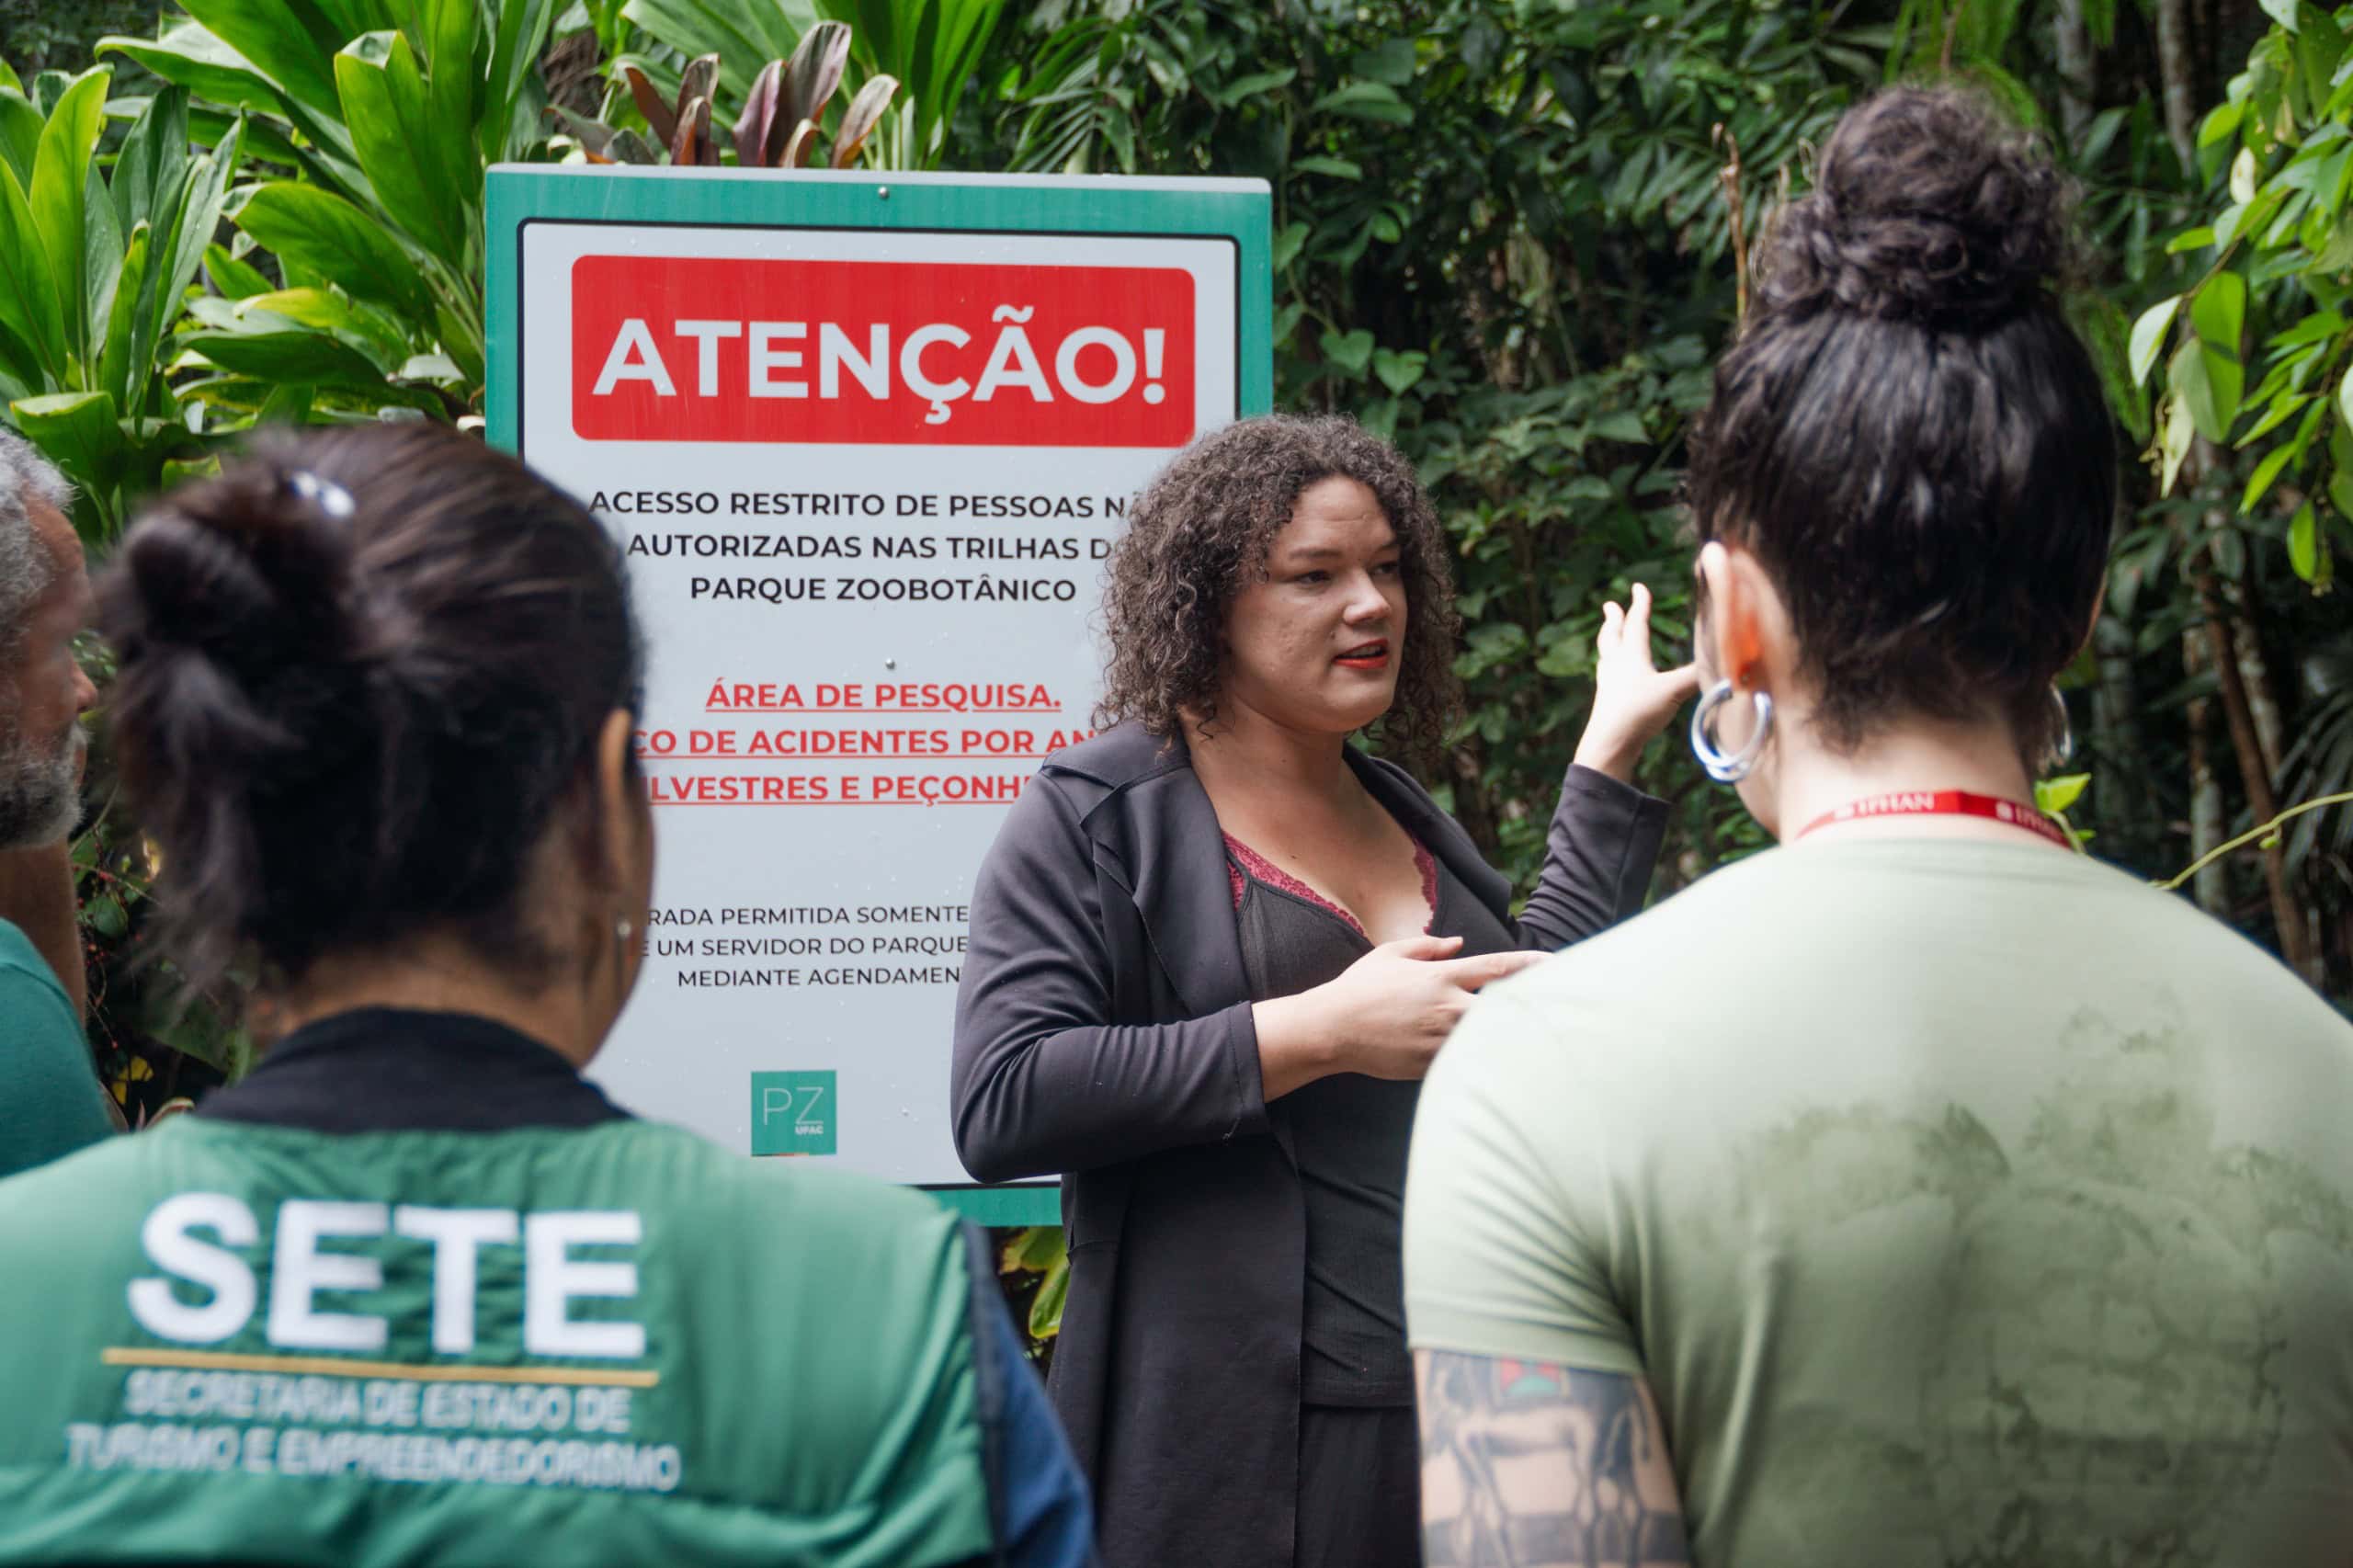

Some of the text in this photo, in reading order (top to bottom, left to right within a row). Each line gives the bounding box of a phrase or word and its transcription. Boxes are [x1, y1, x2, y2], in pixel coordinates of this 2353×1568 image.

[592, 303, 1165, 426] ATENÇÃO!
[588, 491, 720, 514] ACESSO
[730, 493, 885, 516] RESTRITO
[896, 494, 938, 517] DE
[949, 495, 1094, 517] PESSOAS
[627, 534, 862, 558] AUTORIZADAS
[872, 537, 937, 559] NAS
[947, 538, 1079, 560] TRILHAS
[691, 574, 1076, 604] PARQUE ZOOBOTÂNICO
[705, 676, 1062, 712] ÁREA DE PESQUISA.
[689, 730, 736, 754] DE
[748, 729, 949, 754] ACIDENTES
[961, 729, 1035, 754] POR
[643, 775, 1030, 807] LVESTRES E PEÇONH
[647, 905, 969, 926] RADA PERMITIDA SOMENTE
[657, 939, 693, 957] UM
[702, 937, 822, 956] SERVIDOR
[830, 937, 865, 955] DO
[873, 936, 969, 957] PARQUE
[677, 966, 960, 987] MEDIANTE AGENDAMEN
[763, 1086, 824, 1126] PZ
[126, 1191, 646, 1359] SETE
[125, 1368, 632, 1435] SECRETARIA DE ESTADO DE
[67, 1422, 682, 1493] TURISMO E EMPREENDEDORISMO
